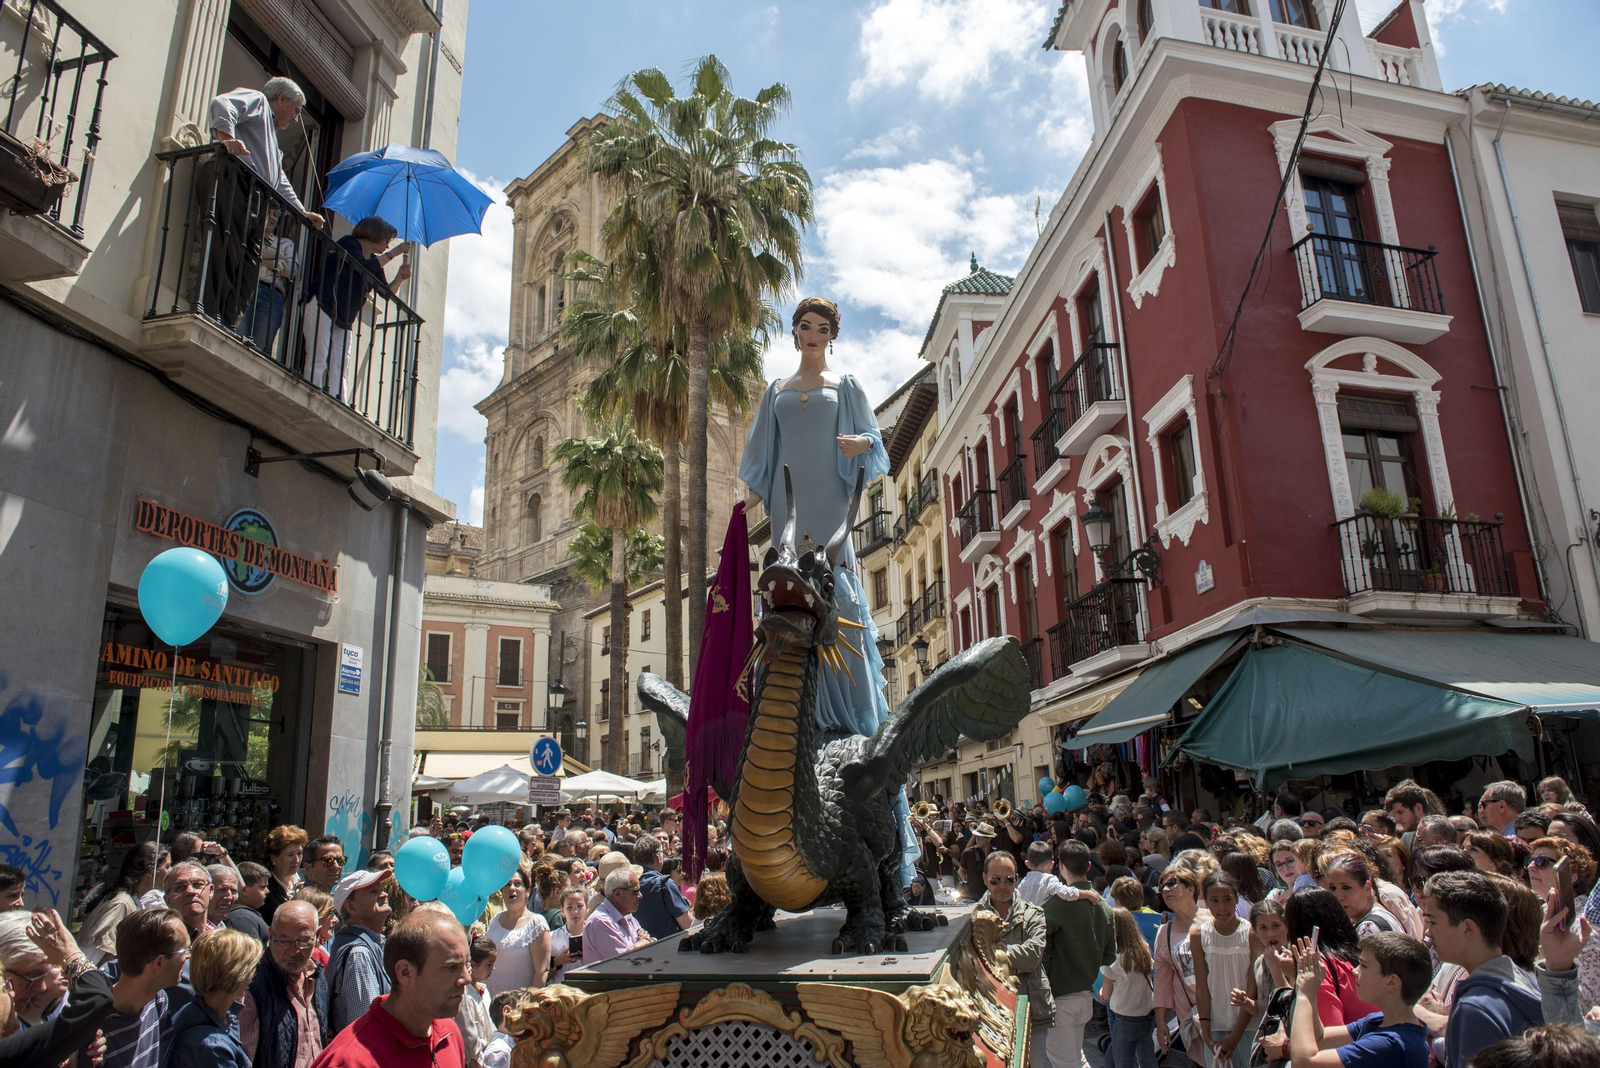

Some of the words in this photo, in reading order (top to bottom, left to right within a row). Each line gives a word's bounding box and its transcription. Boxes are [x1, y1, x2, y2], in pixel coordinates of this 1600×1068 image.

[139, 500, 241, 559] DEPORTES
[243, 537, 266, 568] DE
[267, 546, 337, 592] MONTAÑA
[99, 641, 167, 672] AMINO
[172, 655, 196, 678] DE
[200, 660, 280, 693] SANTIAGO
[343, 647, 359, 657] tyco
[109, 669, 174, 692] EQUIPACION
[177, 681, 183, 694] Y
[185, 683, 263, 707] ASESORAMIENTO
